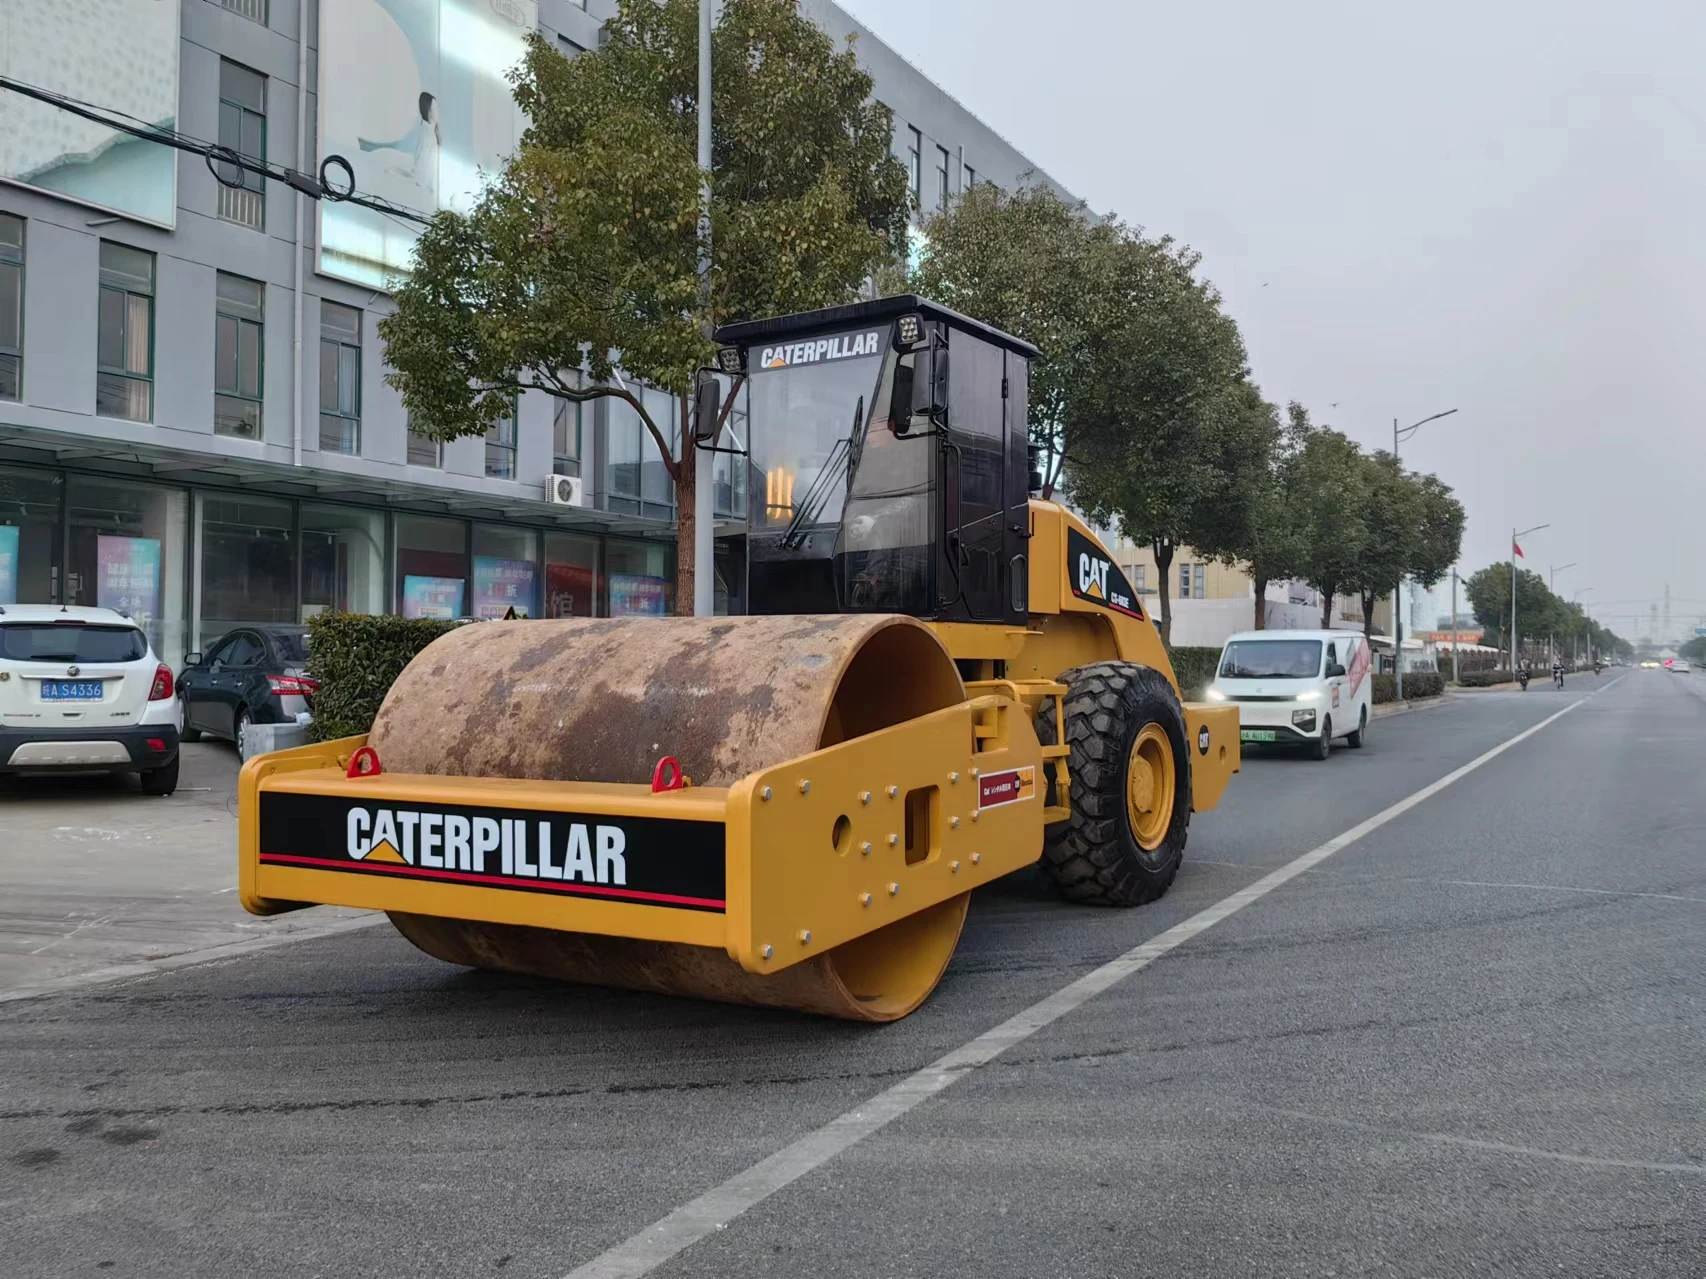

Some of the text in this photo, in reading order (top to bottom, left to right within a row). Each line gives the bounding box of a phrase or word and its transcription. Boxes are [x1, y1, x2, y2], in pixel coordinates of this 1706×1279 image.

[761, 332, 879, 369] CATERPILLAR
[1079, 552, 1109, 600] CAT
[62, 684, 101, 696] S4336
[347, 806, 627, 885] CATERPILLAR
